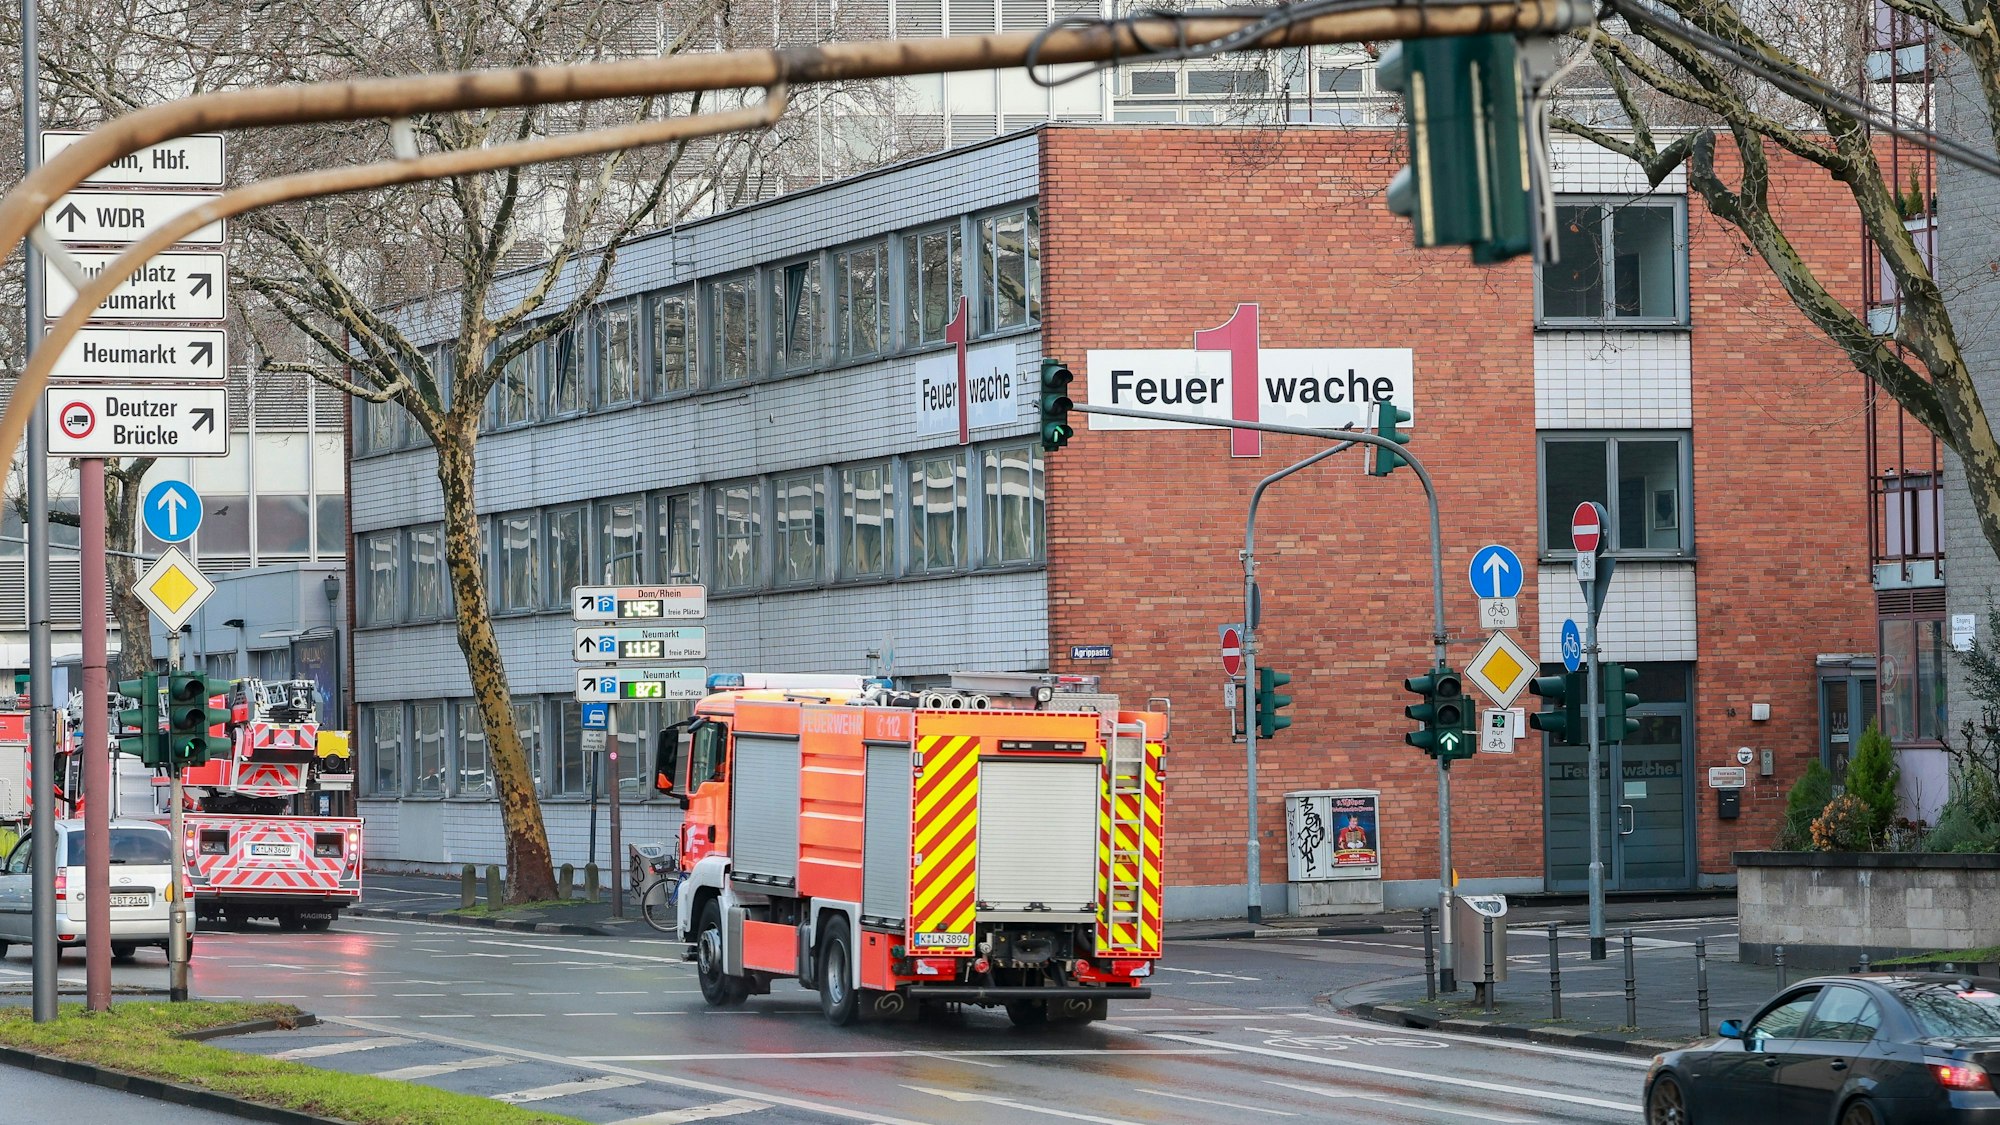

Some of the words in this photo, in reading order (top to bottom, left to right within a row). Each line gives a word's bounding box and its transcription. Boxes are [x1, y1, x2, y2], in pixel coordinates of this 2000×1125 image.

[104, 153, 143, 173] om,
[152, 149, 189, 170] Hbf.
[96, 207, 145, 228] WDR
[98, 289, 176, 310] eumarkt
[83, 341, 177, 365] Heumarkt
[1110, 370, 1225, 405] Feuer
[1194, 302, 1261, 458] 1
[1265, 368, 1395, 404] wache
[922, 378, 957, 412] Feuer
[968, 366, 1011, 404] wache
[106, 396, 178, 417] Deutzer
[113, 424, 178, 445] Brücke
[638, 589, 682, 599] Dom/Rhein
[624, 600, 659, 617] 1452
[642, 630, 680, 638] Neumarkt
[625, 641, 660, 657] 1112
[1074, 647, 1110, 659] Agrippastr.
[643, 671, 681, 679] Neumarkt
[635, 681, 662, 698] 873
[685, 689, 702, 697] Plätze
[802, 711, 863, 736] FEUERWEHR
[886, 715, 900, 737] 112
[1622, 762, 1673, 777] wache
[117, 896, 128, 905] BT
[128, 896, 148, 905] 2161
[300, 912, 332, 920] MAGIRUS
[920, 934, 927, 944] K
[932, 934, 945, 944] LN
[945, 934, 968, 944] 3896
